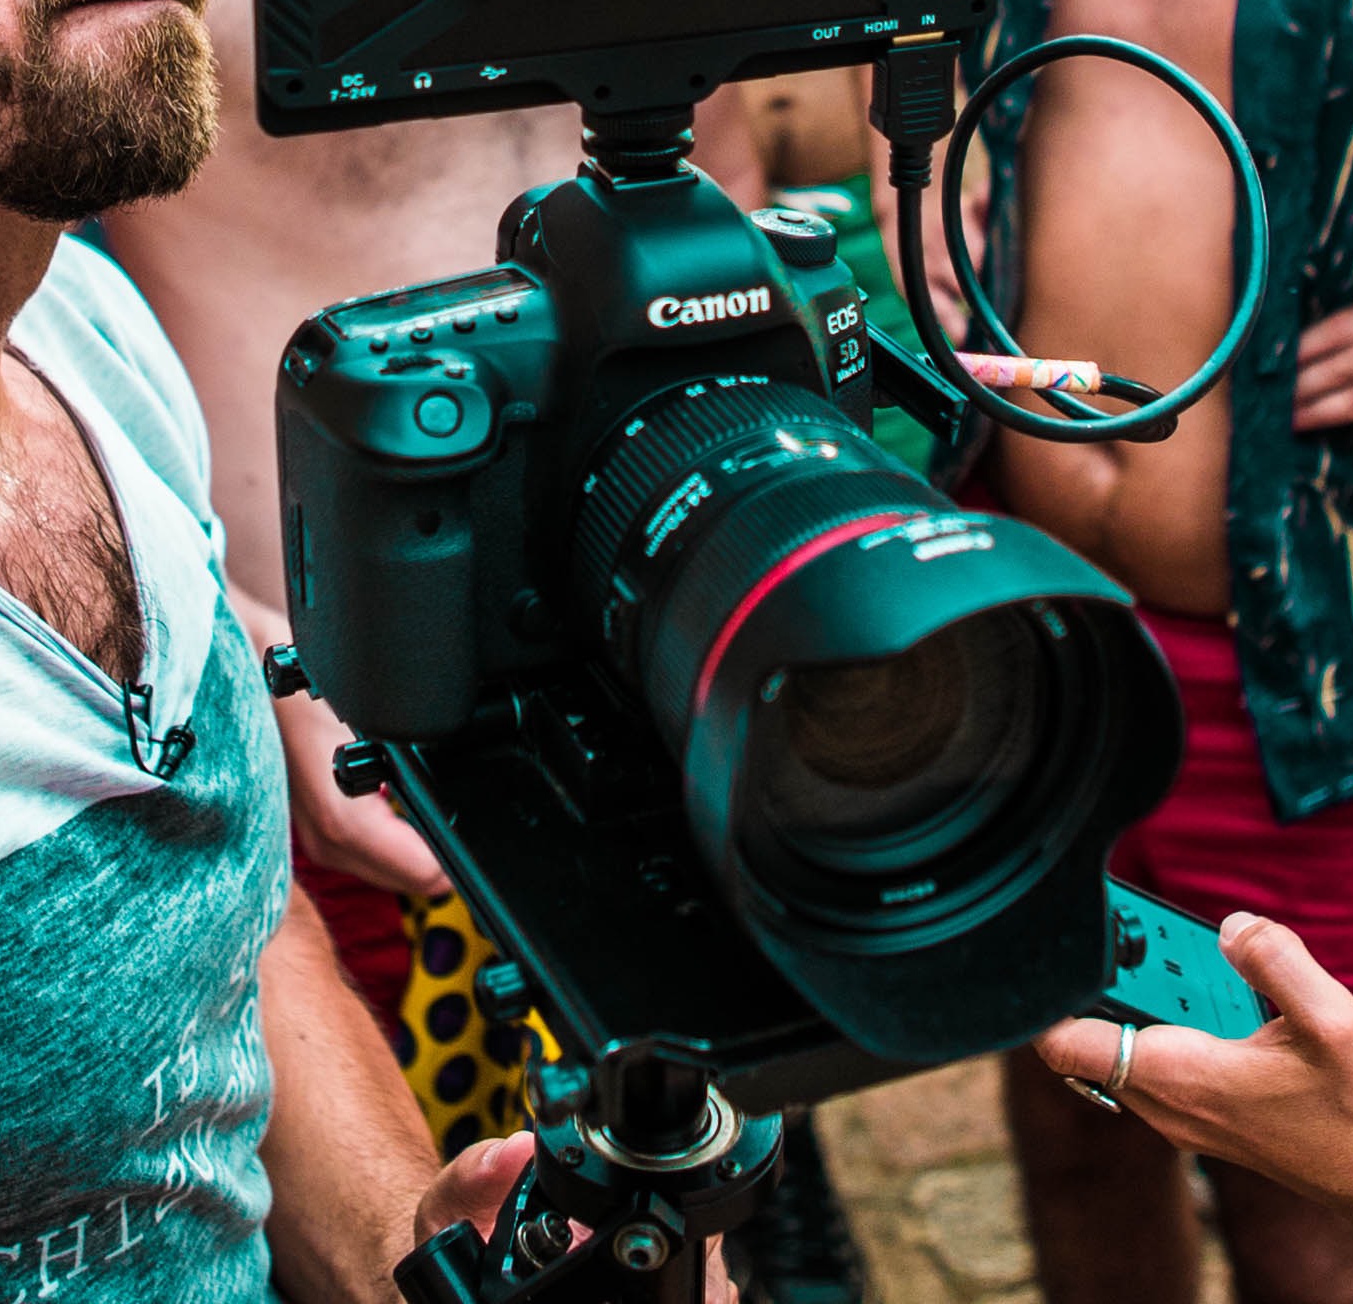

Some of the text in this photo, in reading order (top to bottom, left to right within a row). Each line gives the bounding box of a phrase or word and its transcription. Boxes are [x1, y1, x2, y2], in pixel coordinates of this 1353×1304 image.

[812, 14, 936, 40] OUT HDMI IN
[341, 72, 364, 87] DC
[648, 286, 770, 328] Canon
[827, 302, 858, 335] EOS
[839, 337, 859, 364] 5D
